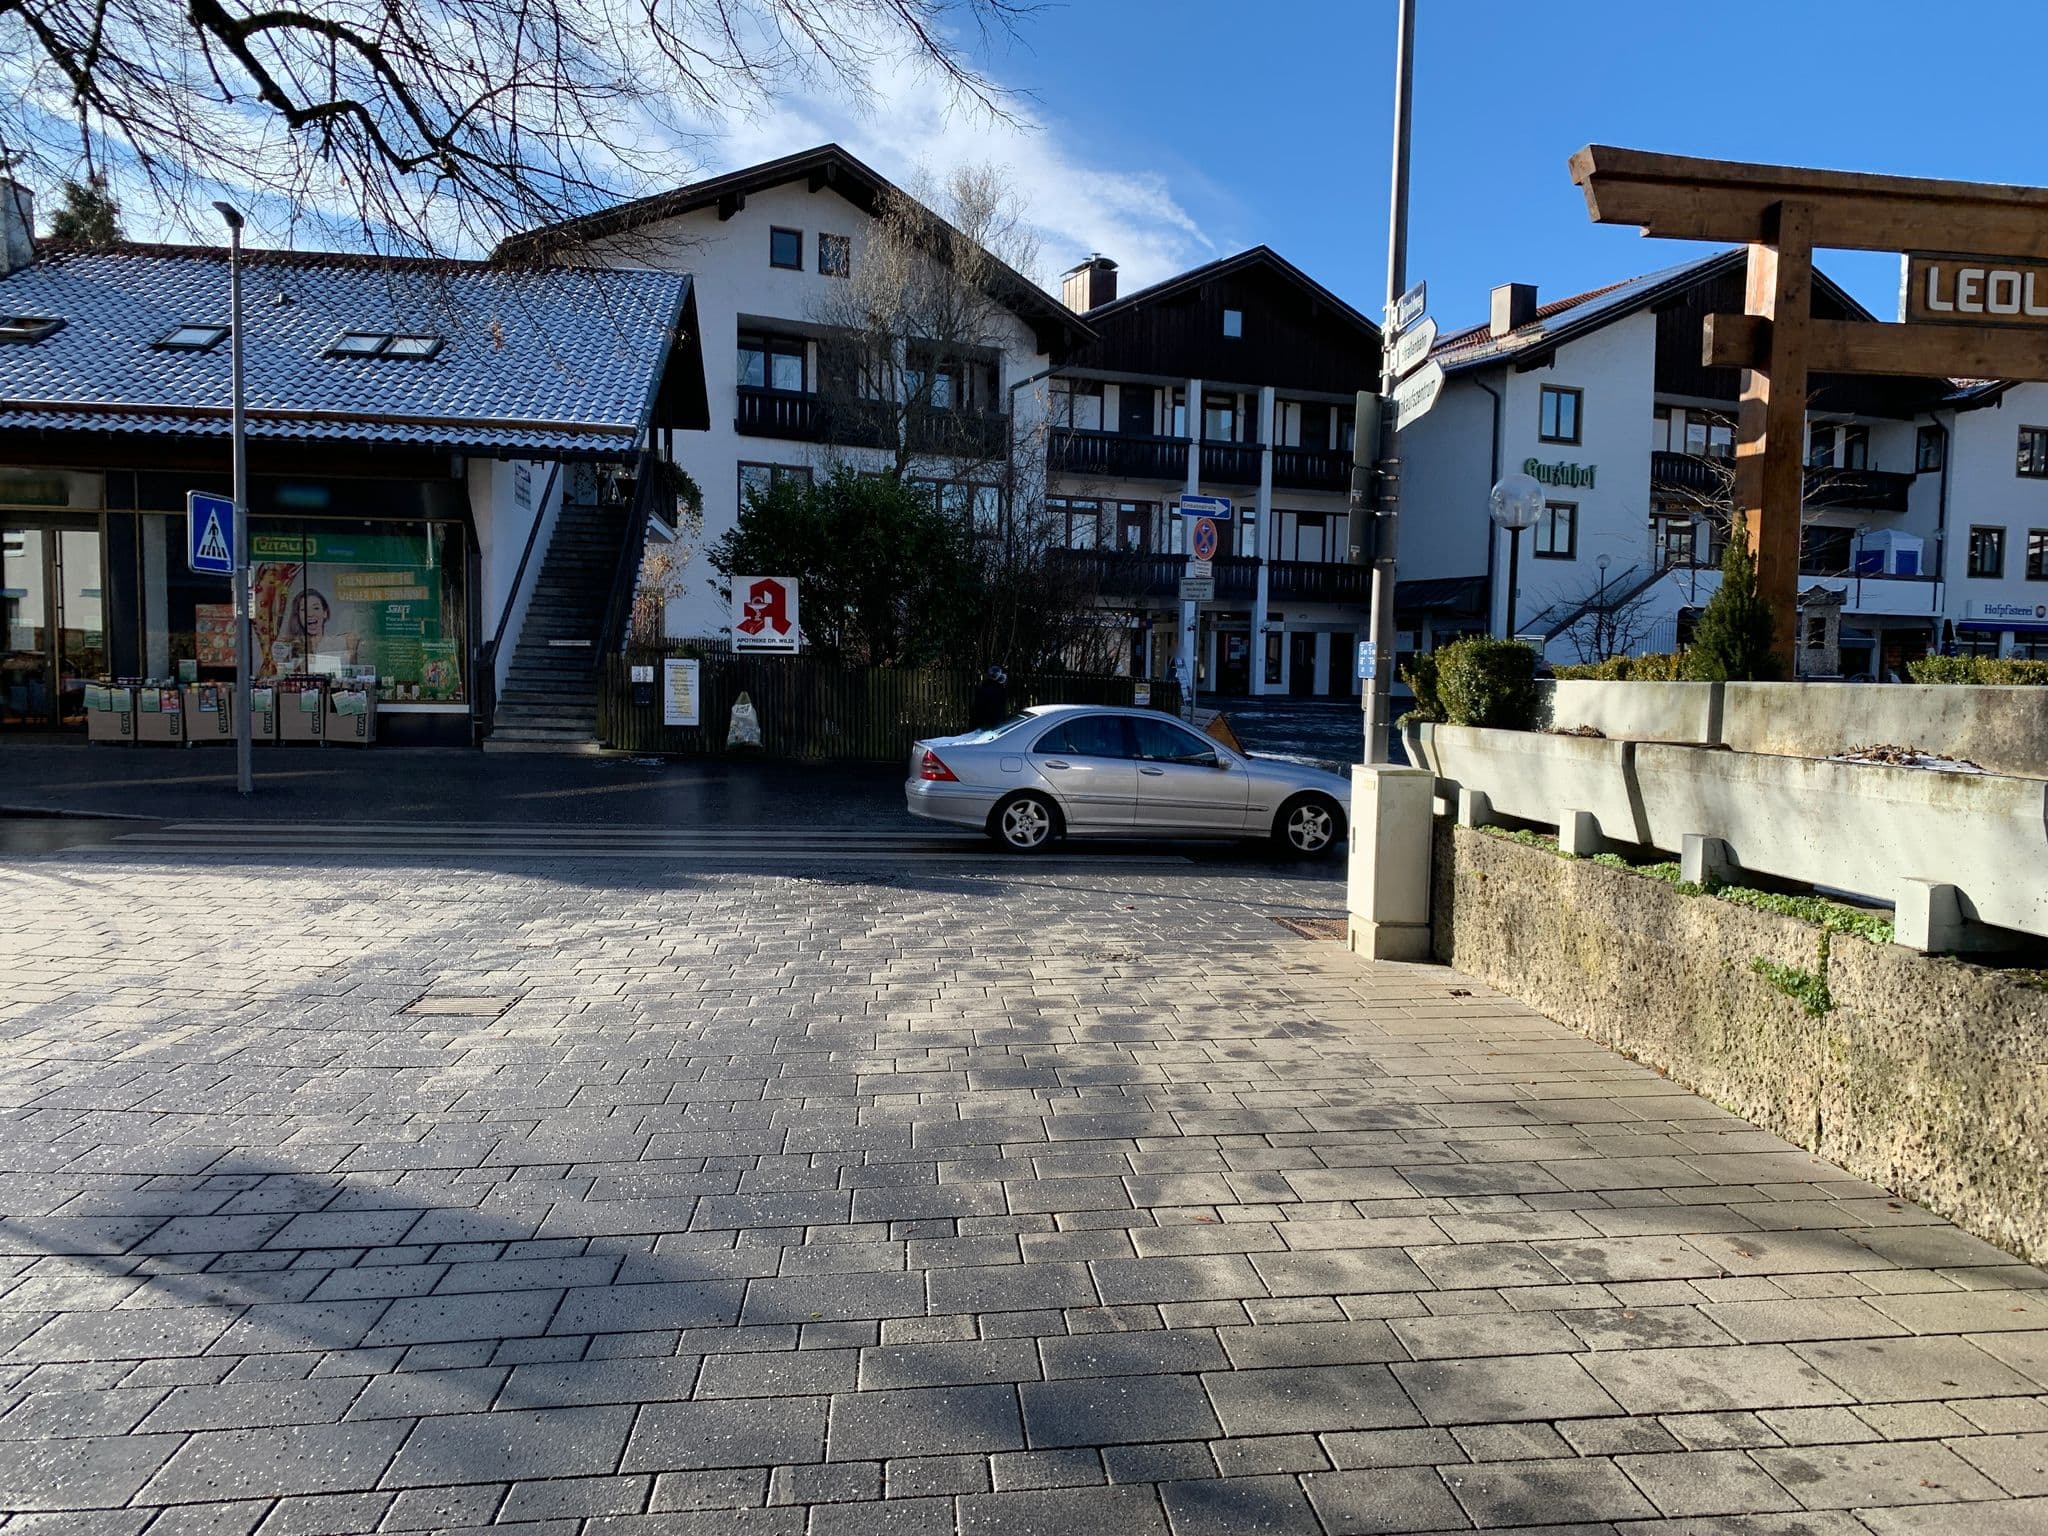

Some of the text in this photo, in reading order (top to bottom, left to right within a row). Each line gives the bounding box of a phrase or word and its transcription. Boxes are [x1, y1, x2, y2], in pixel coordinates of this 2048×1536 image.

[1928, 266, 2048, 316] LEOL
[1399, 379, 1436, 414] nkaufszentrum
[1984, 603, 2033, 617] Hofpfisterei
[218, 699, 228, 733] VITALIA
